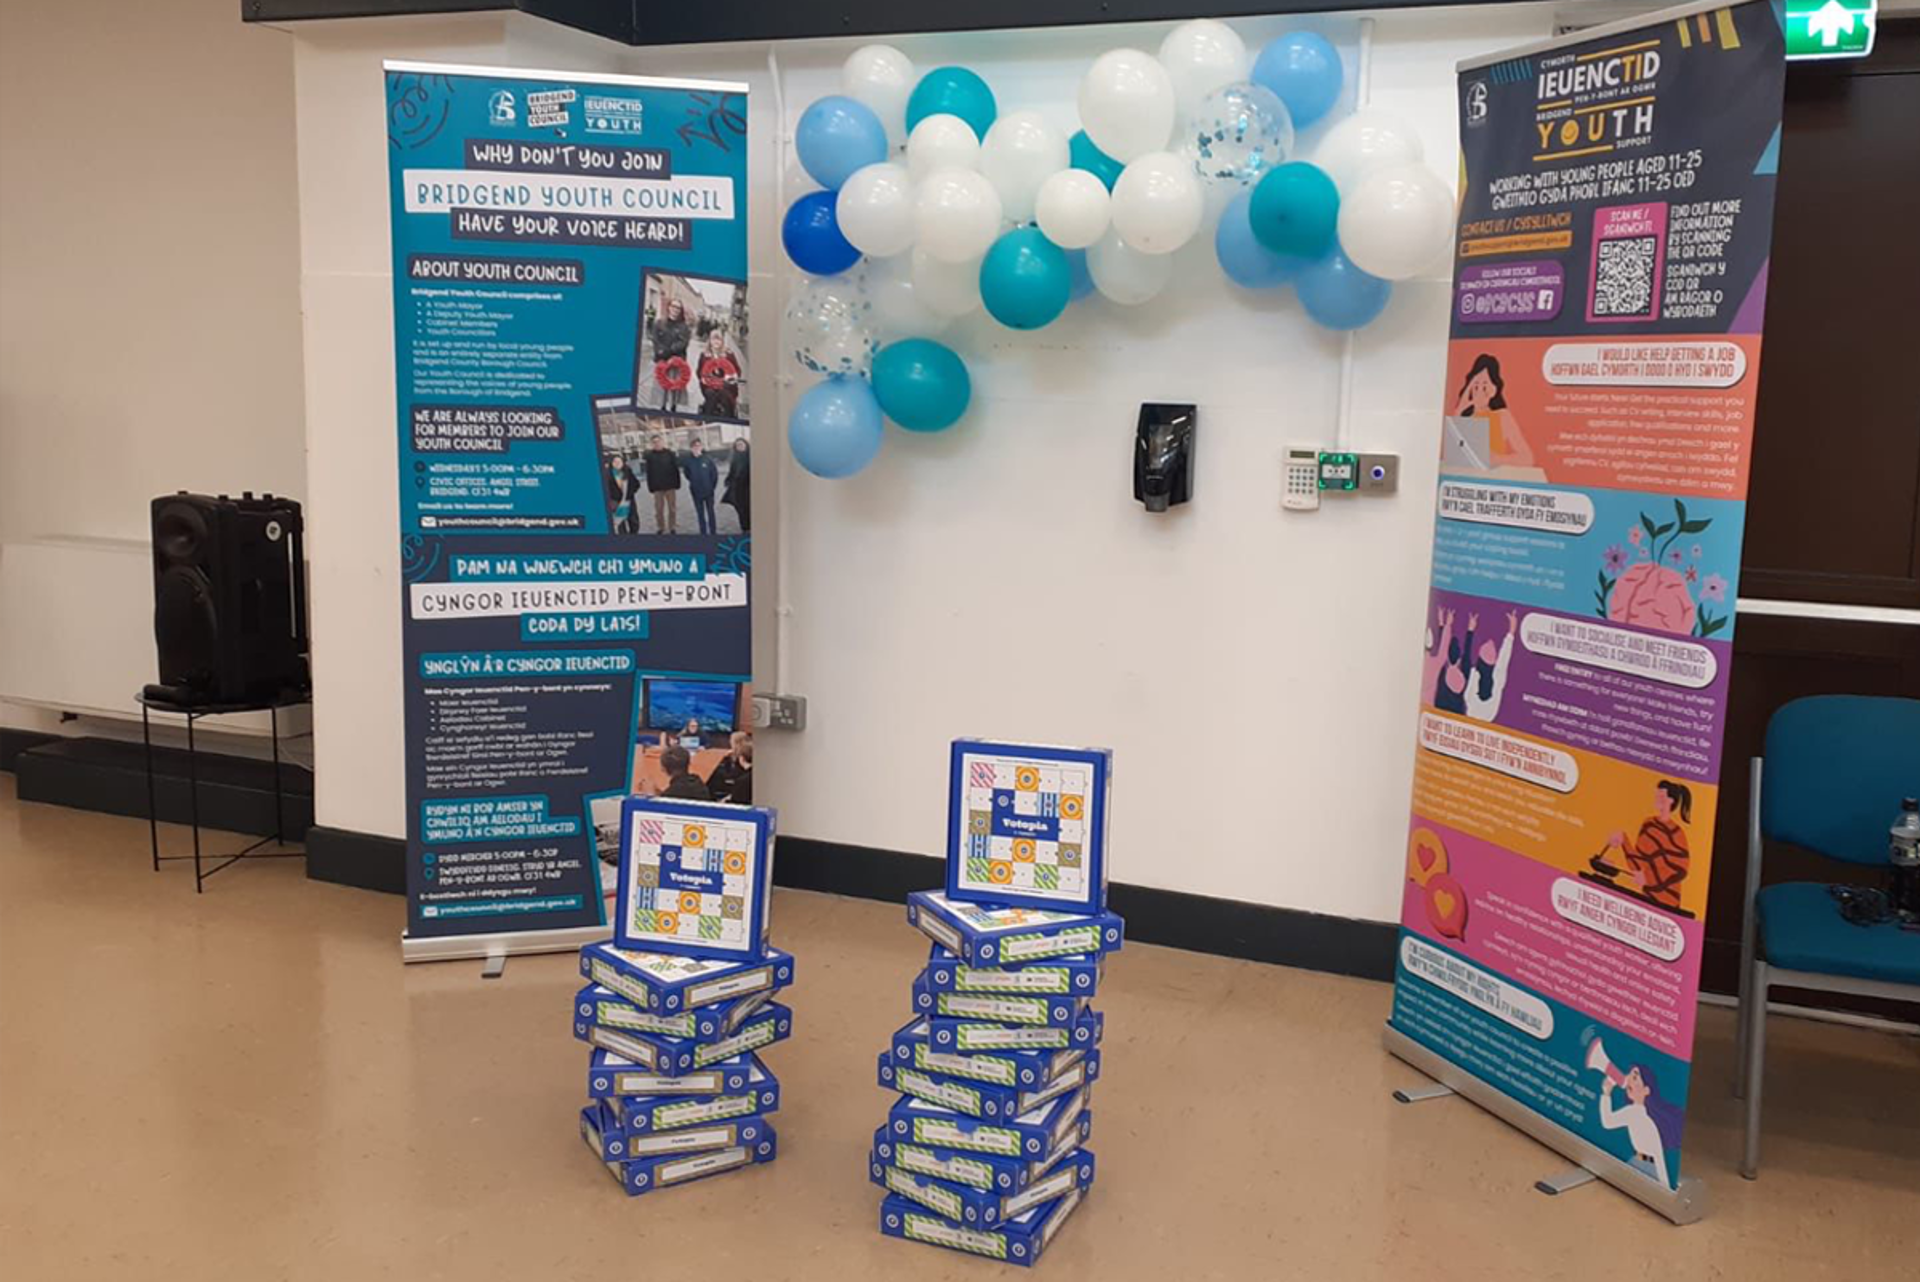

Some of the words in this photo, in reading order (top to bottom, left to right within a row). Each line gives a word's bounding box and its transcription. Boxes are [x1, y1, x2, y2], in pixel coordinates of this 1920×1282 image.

[1540, 54, 1575, 70] CYMORTH
[1537, 51, 1661, 100] IEUENCTID
[529, 92, 574, 103] BRIDGEND
[530, 104, 559, 115] YOUTH
[585, 101, 642, 112] IEUENCTID
[1536, 107, 1572, 121] BRIDGEND
[529, 113, 567, 125] COUNCIL
[586, 118, 642, 131] YOUTH
[1537, 104, 1653, 149] YOUTH
[1616, 136, 1652, 150] SUPPORT
[473, 144, 513, 164] WHY
[521, 146, 575, 166] DON'T
[579, 148, 614, 169] YOU
[622, 151, 663, 171] JOIN
[1490, 174, 1532, 195] WORKING
[1534, 171, 1558, 188] WITH
[1560, 166, 1596, 186] YOUNG
[1597, 160, 1634, 181] PEOPLE
[1637, 156, 1666, 174] AGED
[1668, 152, 1702, 170] 11-25
[1638, 172, 1672, 192] 11-25
[1673, 170, 1695, 188] OED
[417, 183, 531, 206] BRIDGEND
[541, 185, 612, 208] YOUTH
[622, 188, 722, 211] COUNCIL
[1692, 203, 1710, 215] OUT
[1712, 200, 1741, 214] MORE
[458, 213, 504, 233] HAVE
[512, 216, 559, 236] YOUR
[568, 218, 617, 238] VOICE
[625, 221, 683, 241] HEARD!
[1670, 215, 1734, 232] INFORMATION
[1681, 229, 1732, 244] SCANNING
[1697, 243, 1724, 256] CODE
[412, 260, 459, 277] ABOUT
[463, 262, 510, 279] YOUTH
[514, 265, 578, 282] COUNCIL
[1716, 347, 1735, 361] JOB
[415, 410, 430, 422] WE
[432, 411, 452, 422] ARE
[455, 411, 499, 423] ALWAYS
[502, 412, 552, 424] LOOKING
[415, 424, 435, 434] FOR
[438, 424, 487, 436] MEMBERS
[490, 426, 504, 436] TO
[507, 426, 534, 437] JOIN
[536, 427, 559, 438] OUR
[415, 438, 451, 449] YOUTH
[453, 439, 503, 450] COUNCIL
[456, 559, 489, 575] PAM
[496, 560, 518, 575] NA
[523, 559, 592, 575] WNEWCH
[598, 559, 622, 574] CHI
[628, 559, 682, 574] YMUNO
[422, 591, 503, 611] CYNGOR
[511, 587, 609, 609] IEUENCTID
[618, 583, 731, 605] PEN-Y-BONT
[528, 617, 568, 633] CODA
[574, 616, 595, 633] DY
[601, 614, 641, 631] LAIS!
[507, 657, 562, 672] CYNGOR
[566, 656, 630, 671] IEUENCTID
[1002, 818, 1048, 831] Votopia
[669, 872, 713, 885] Votopia
